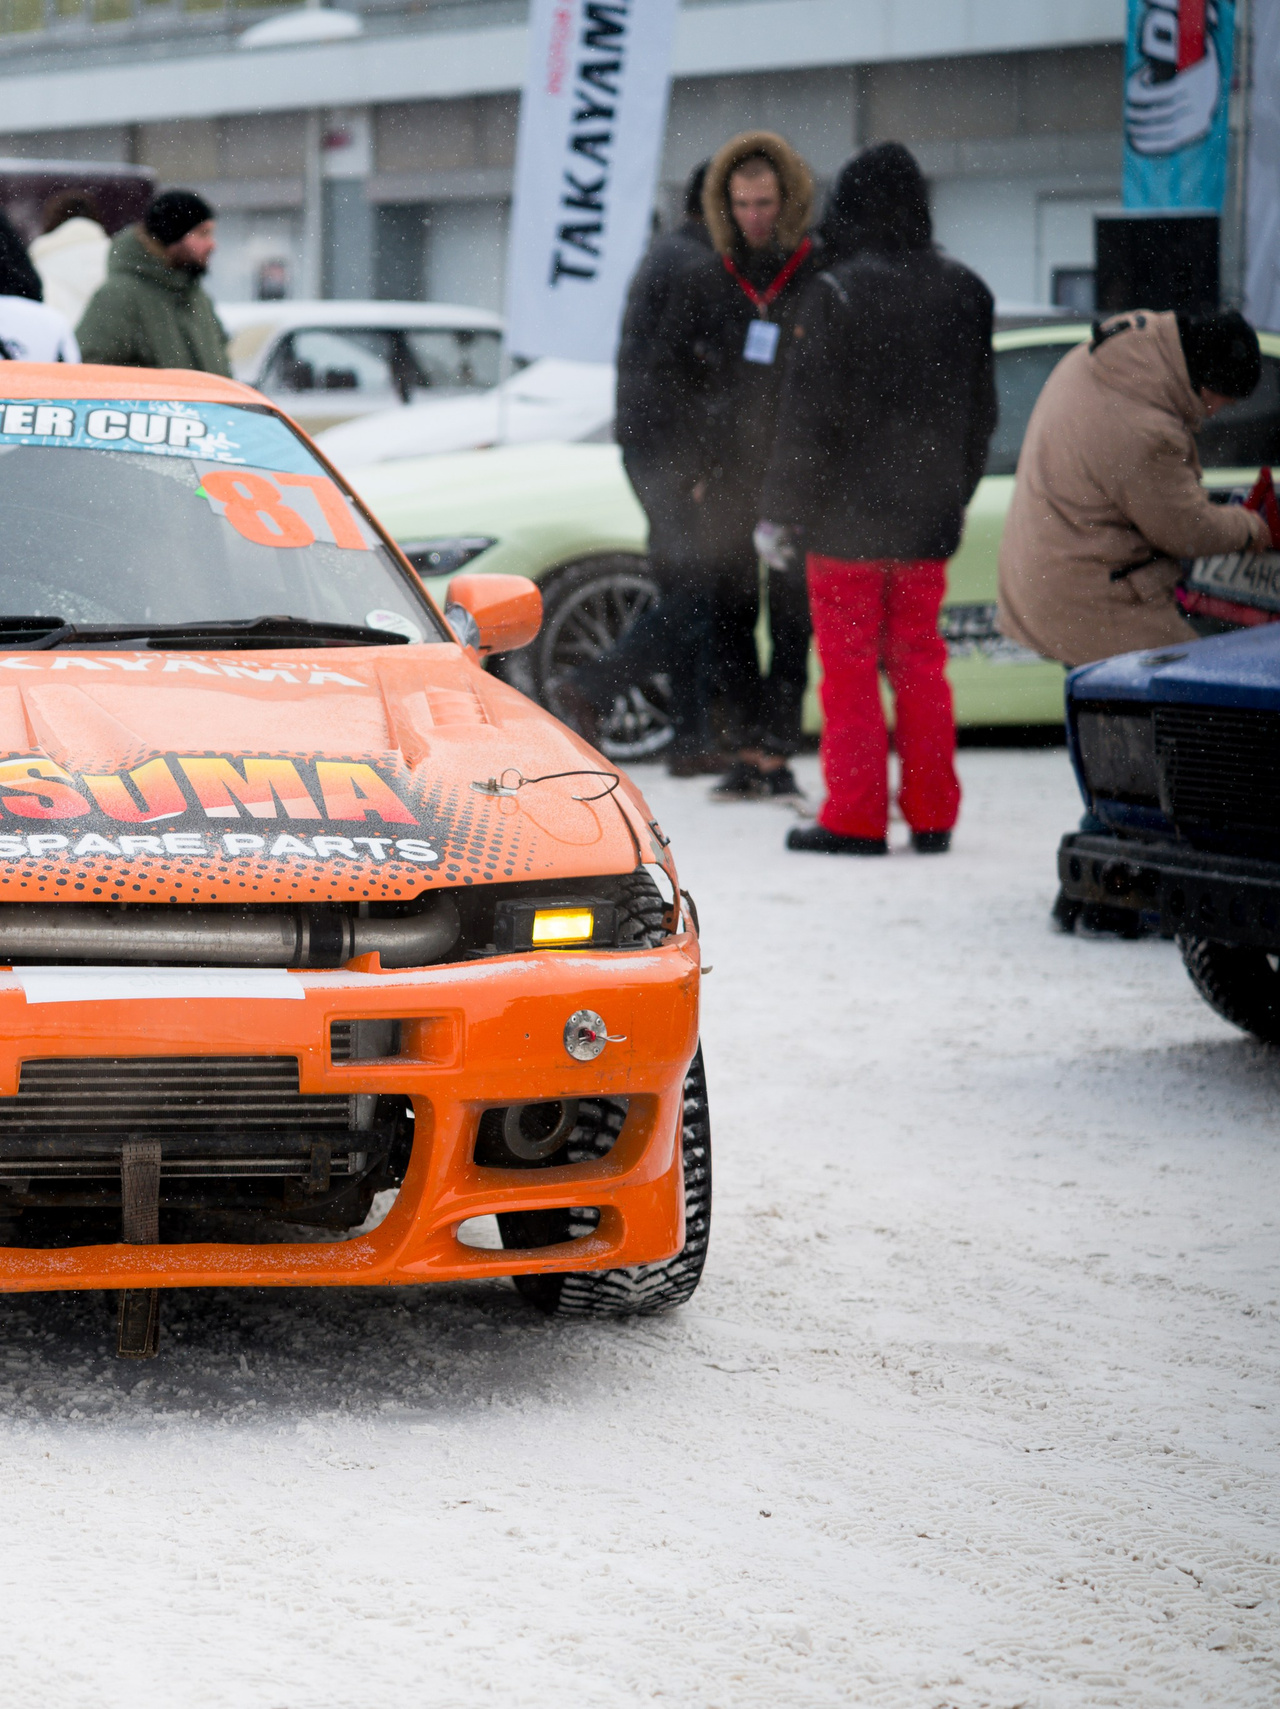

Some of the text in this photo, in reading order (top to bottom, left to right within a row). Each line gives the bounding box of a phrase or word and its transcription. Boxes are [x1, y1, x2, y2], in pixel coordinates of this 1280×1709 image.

[87, 408, 208, 446] CUP
[200, 470, 370, 550] 87
[133, 652, 332, 671] MOTOR OIL
[221, 833, 439, 861] PARTS
